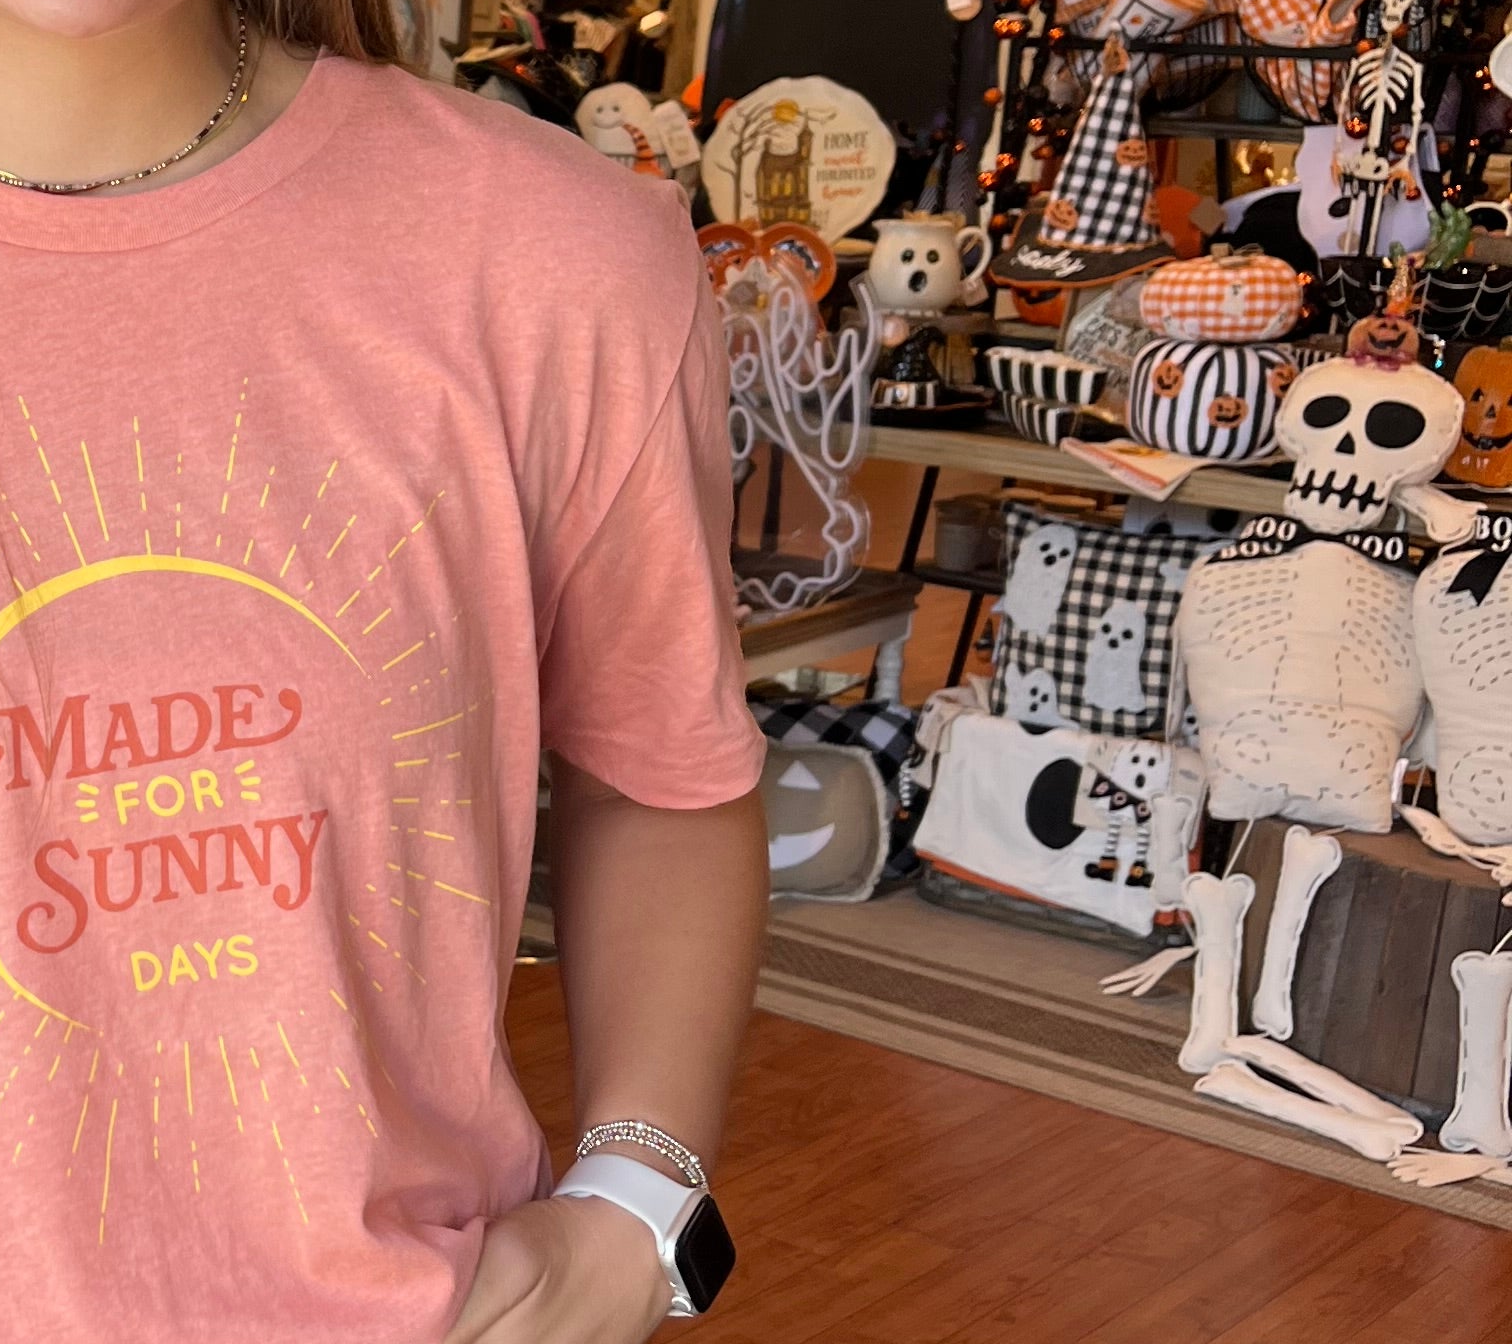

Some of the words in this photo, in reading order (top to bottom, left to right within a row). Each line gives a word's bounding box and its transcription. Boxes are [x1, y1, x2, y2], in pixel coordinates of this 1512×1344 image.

[113, 768, 225, 826] FOR
[16, 809, 330, 955] SUNNY
[130, 933, 261, 993] DAYS
